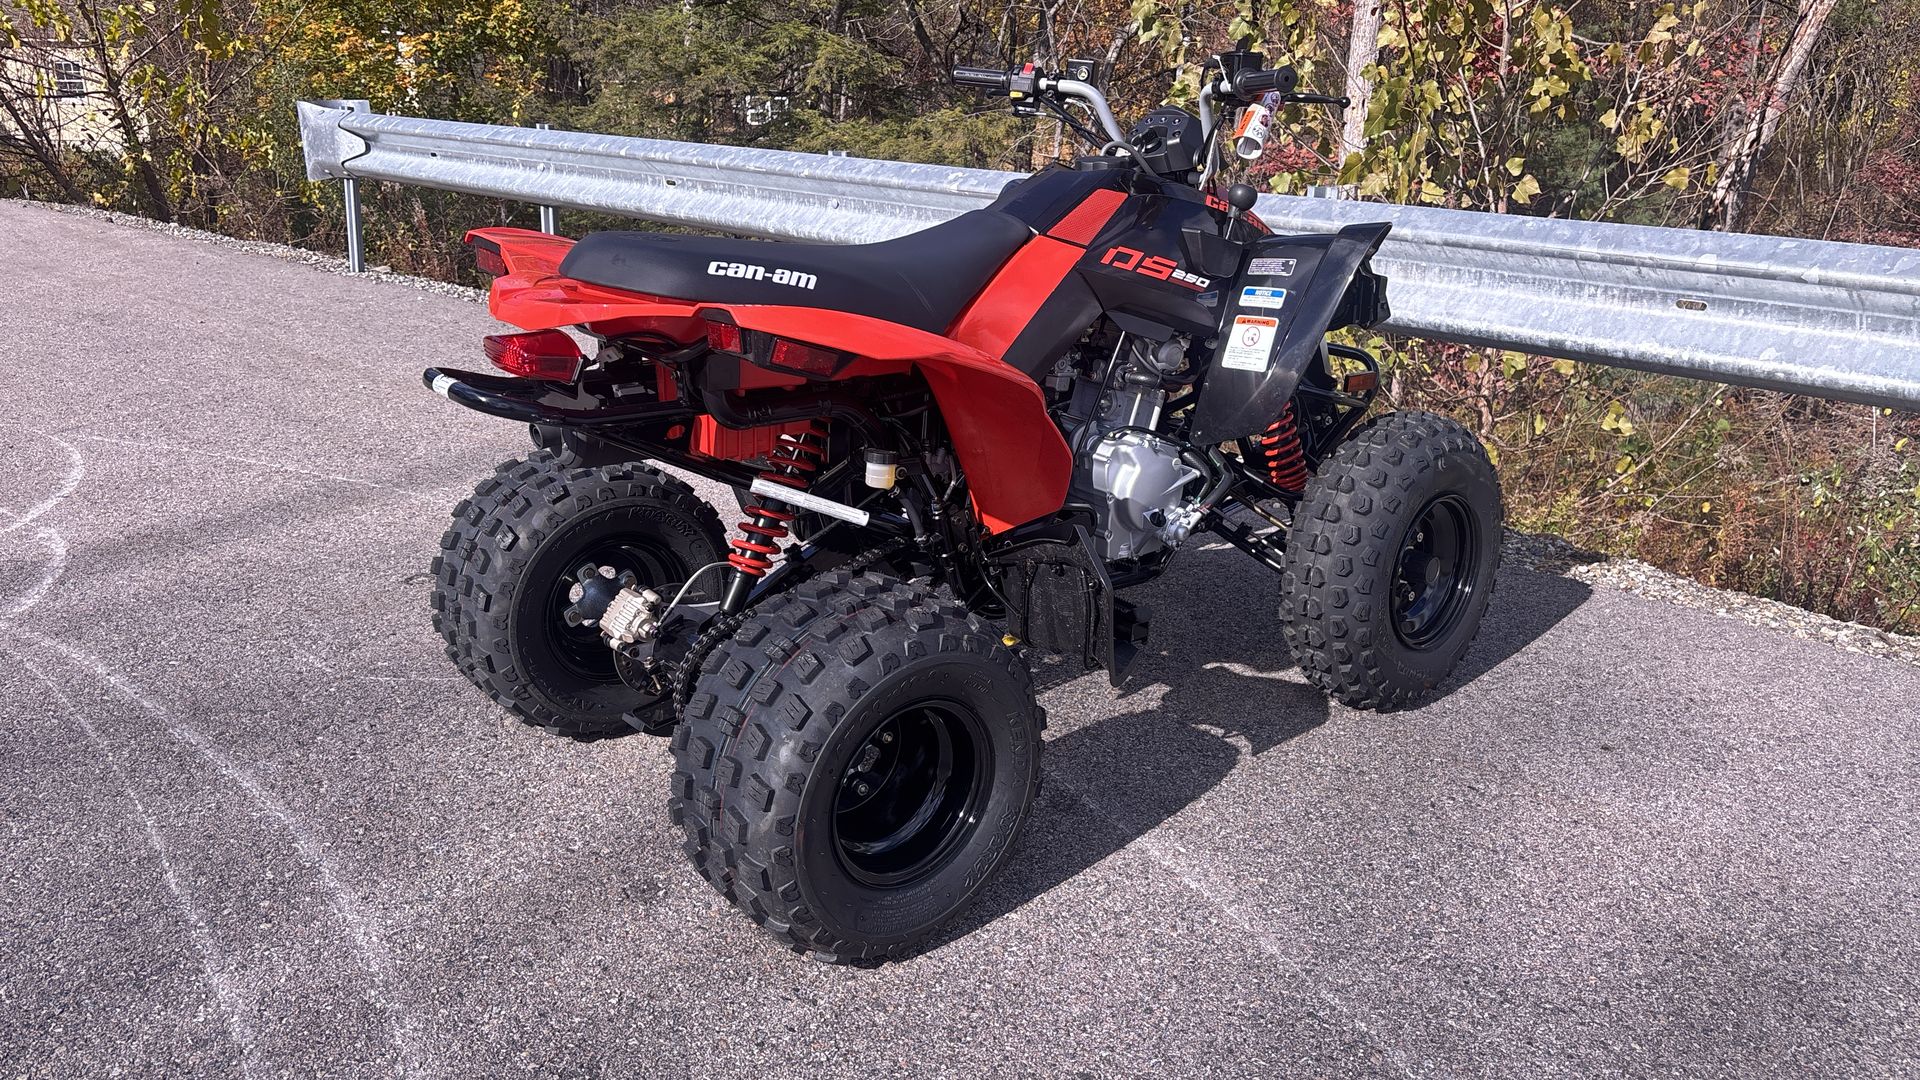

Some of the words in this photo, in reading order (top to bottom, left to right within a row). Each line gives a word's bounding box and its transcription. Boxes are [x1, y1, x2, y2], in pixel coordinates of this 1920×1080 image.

[707, 261, 817, 290] can-am
[1171, 268, 1211, 288] 250
[1006, 711, 1026, 789] KENDA
